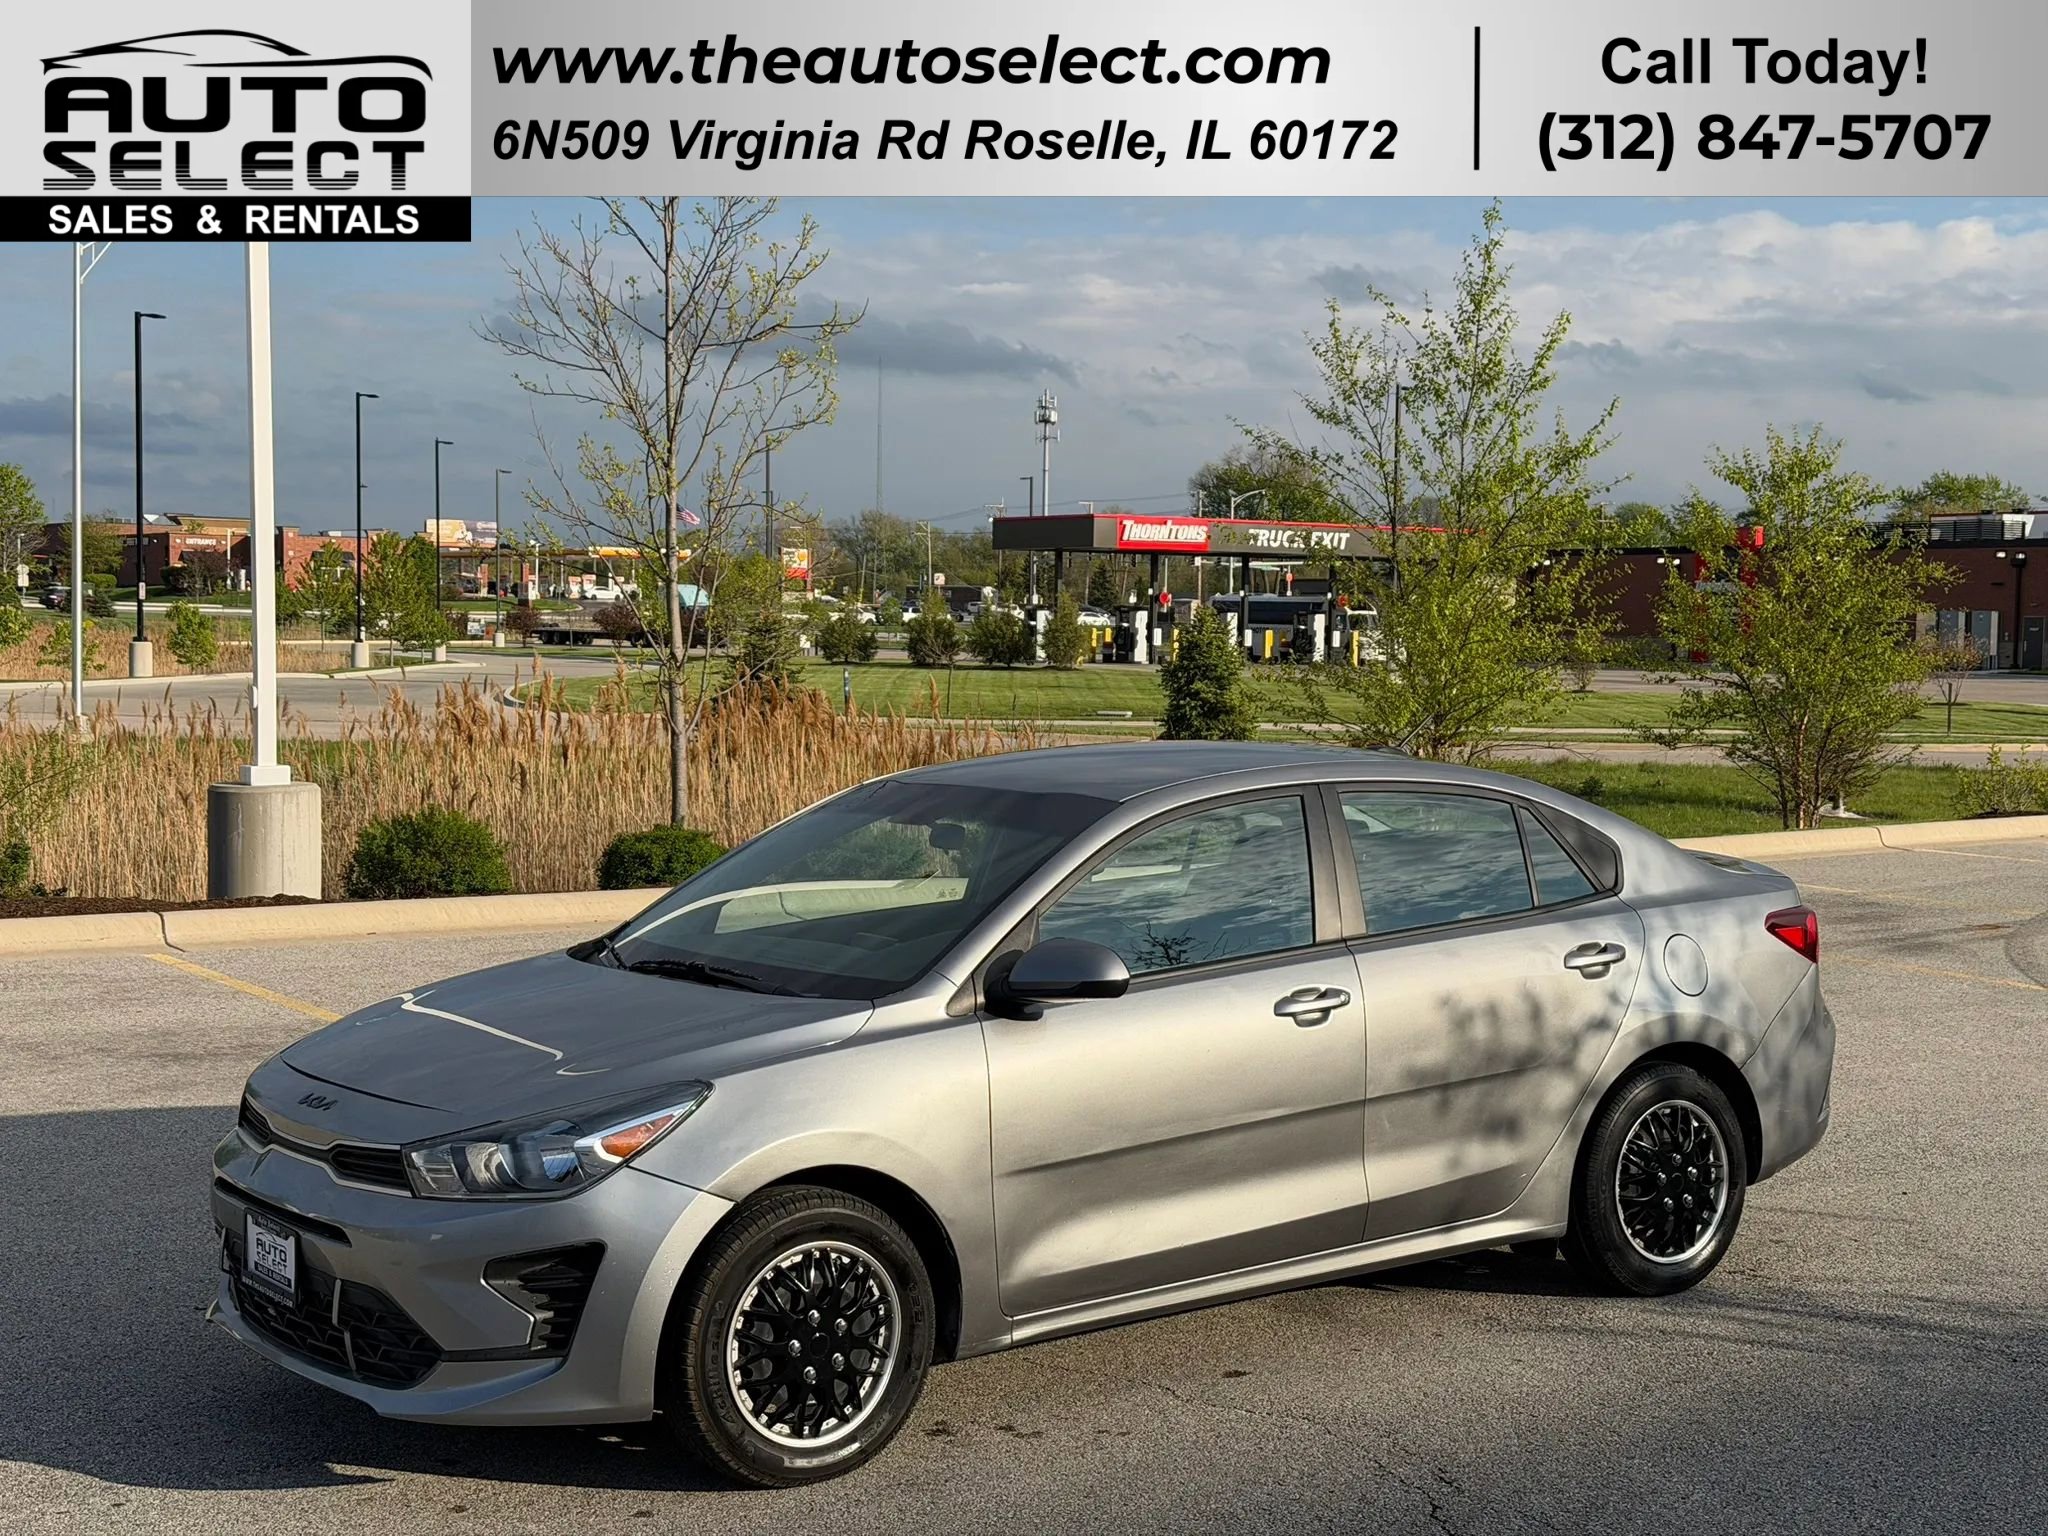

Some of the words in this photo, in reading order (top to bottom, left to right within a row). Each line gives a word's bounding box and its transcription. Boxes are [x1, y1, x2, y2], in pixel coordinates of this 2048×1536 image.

[185, 537, 217, 546] ENTRANCE
[1311, 531, 1351, 550] EXIT
[297, 1092, 338, 1111] KIA
[256, 1237, 287, 1263] AUTO
[256, 1250, 288, 1275] SELECT
